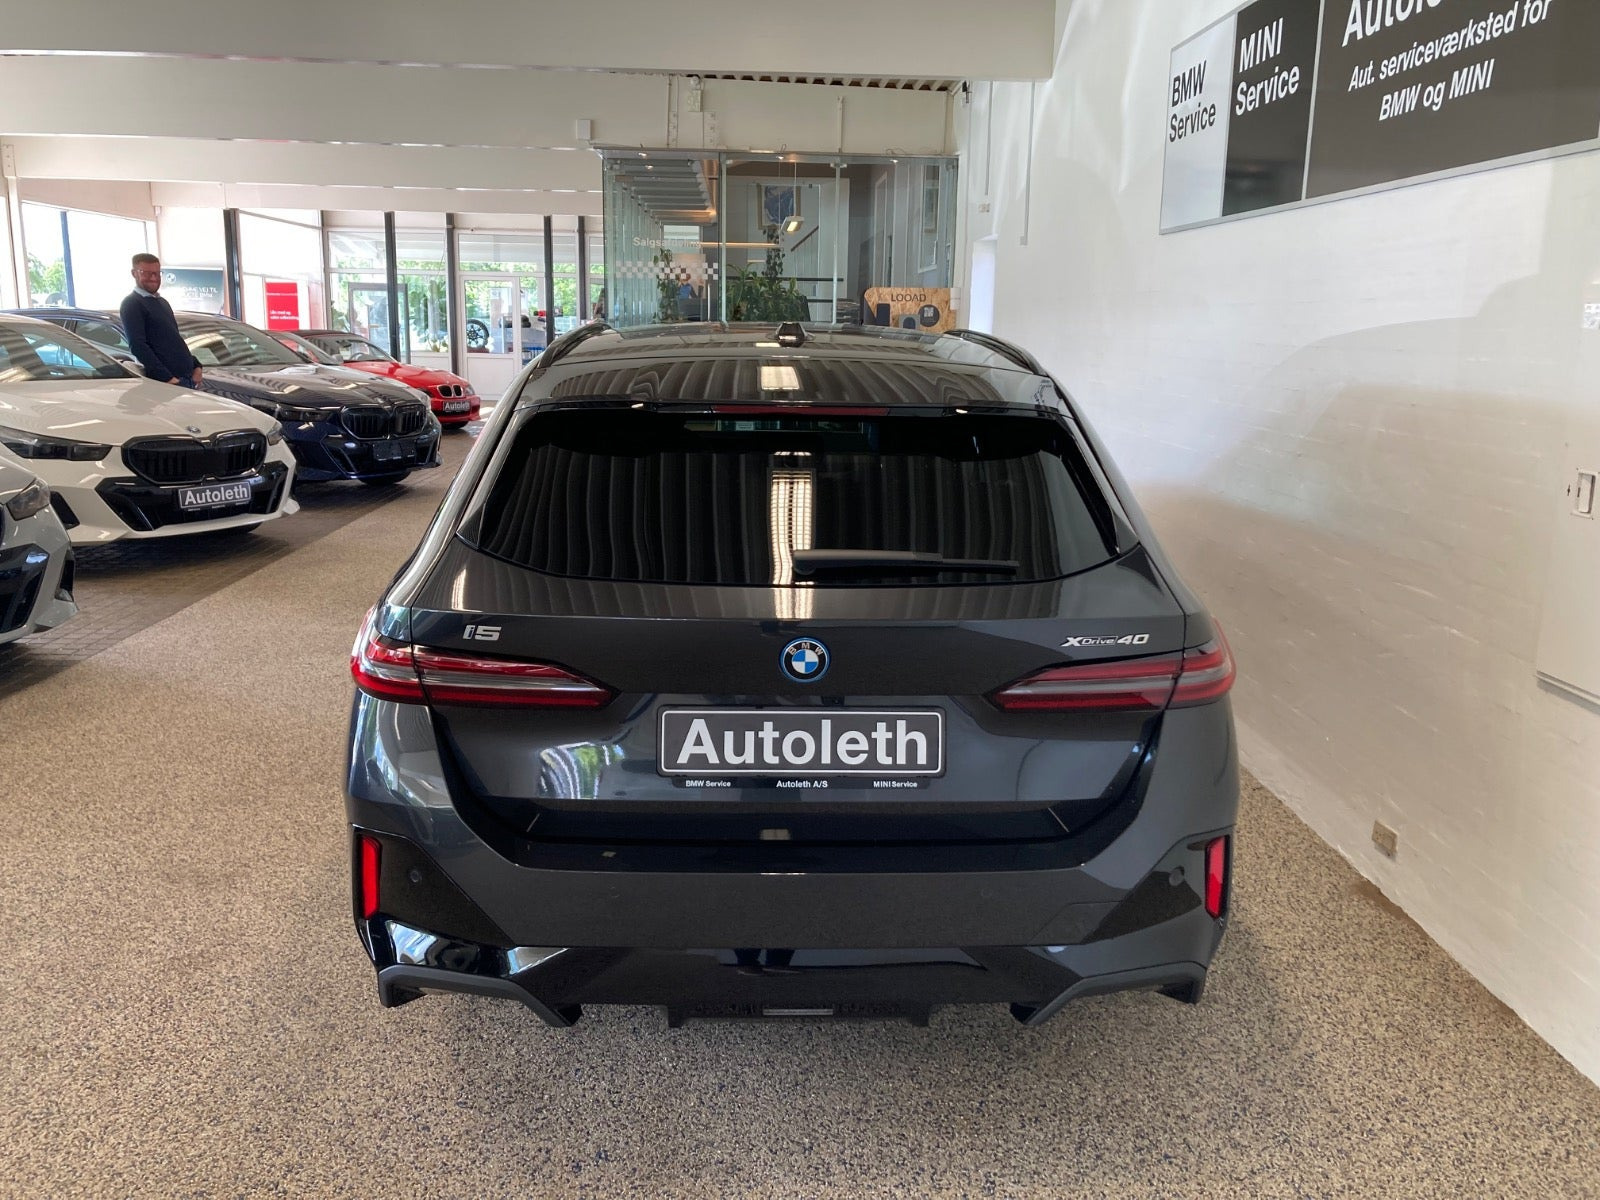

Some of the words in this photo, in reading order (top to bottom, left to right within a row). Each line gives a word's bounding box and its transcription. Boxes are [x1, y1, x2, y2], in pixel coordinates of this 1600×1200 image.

[1238, 18, 1285, 73] MINI
[1348, 60, 1375, 92] Aut.
[1379, 1, 1519, 80] serviceværksted
[1521, 0, 1551, 28] for
[1171, 60, 1207, 107] BMW
[1236, 65, 1300, 116] Service
[1379, 83, 1422, 121] BMW
[1423, 81, 1446, 112] og
[1449, 58, 1496, 99] MINI
[1169, 102, 1217, 143] Service
[890, 293, 927, 303] LOOAD
[184, 485, 248, 505] Autoleth
[788, 642, 824, 656] BMW
[676, 718, 927, 765] Autoleth
[776, 780, 811, 788] Autoleth
[812, 780, 828, 788] A/S
[873, 780, 891, 788] MINI
[891, 780, 918, 788] Service
